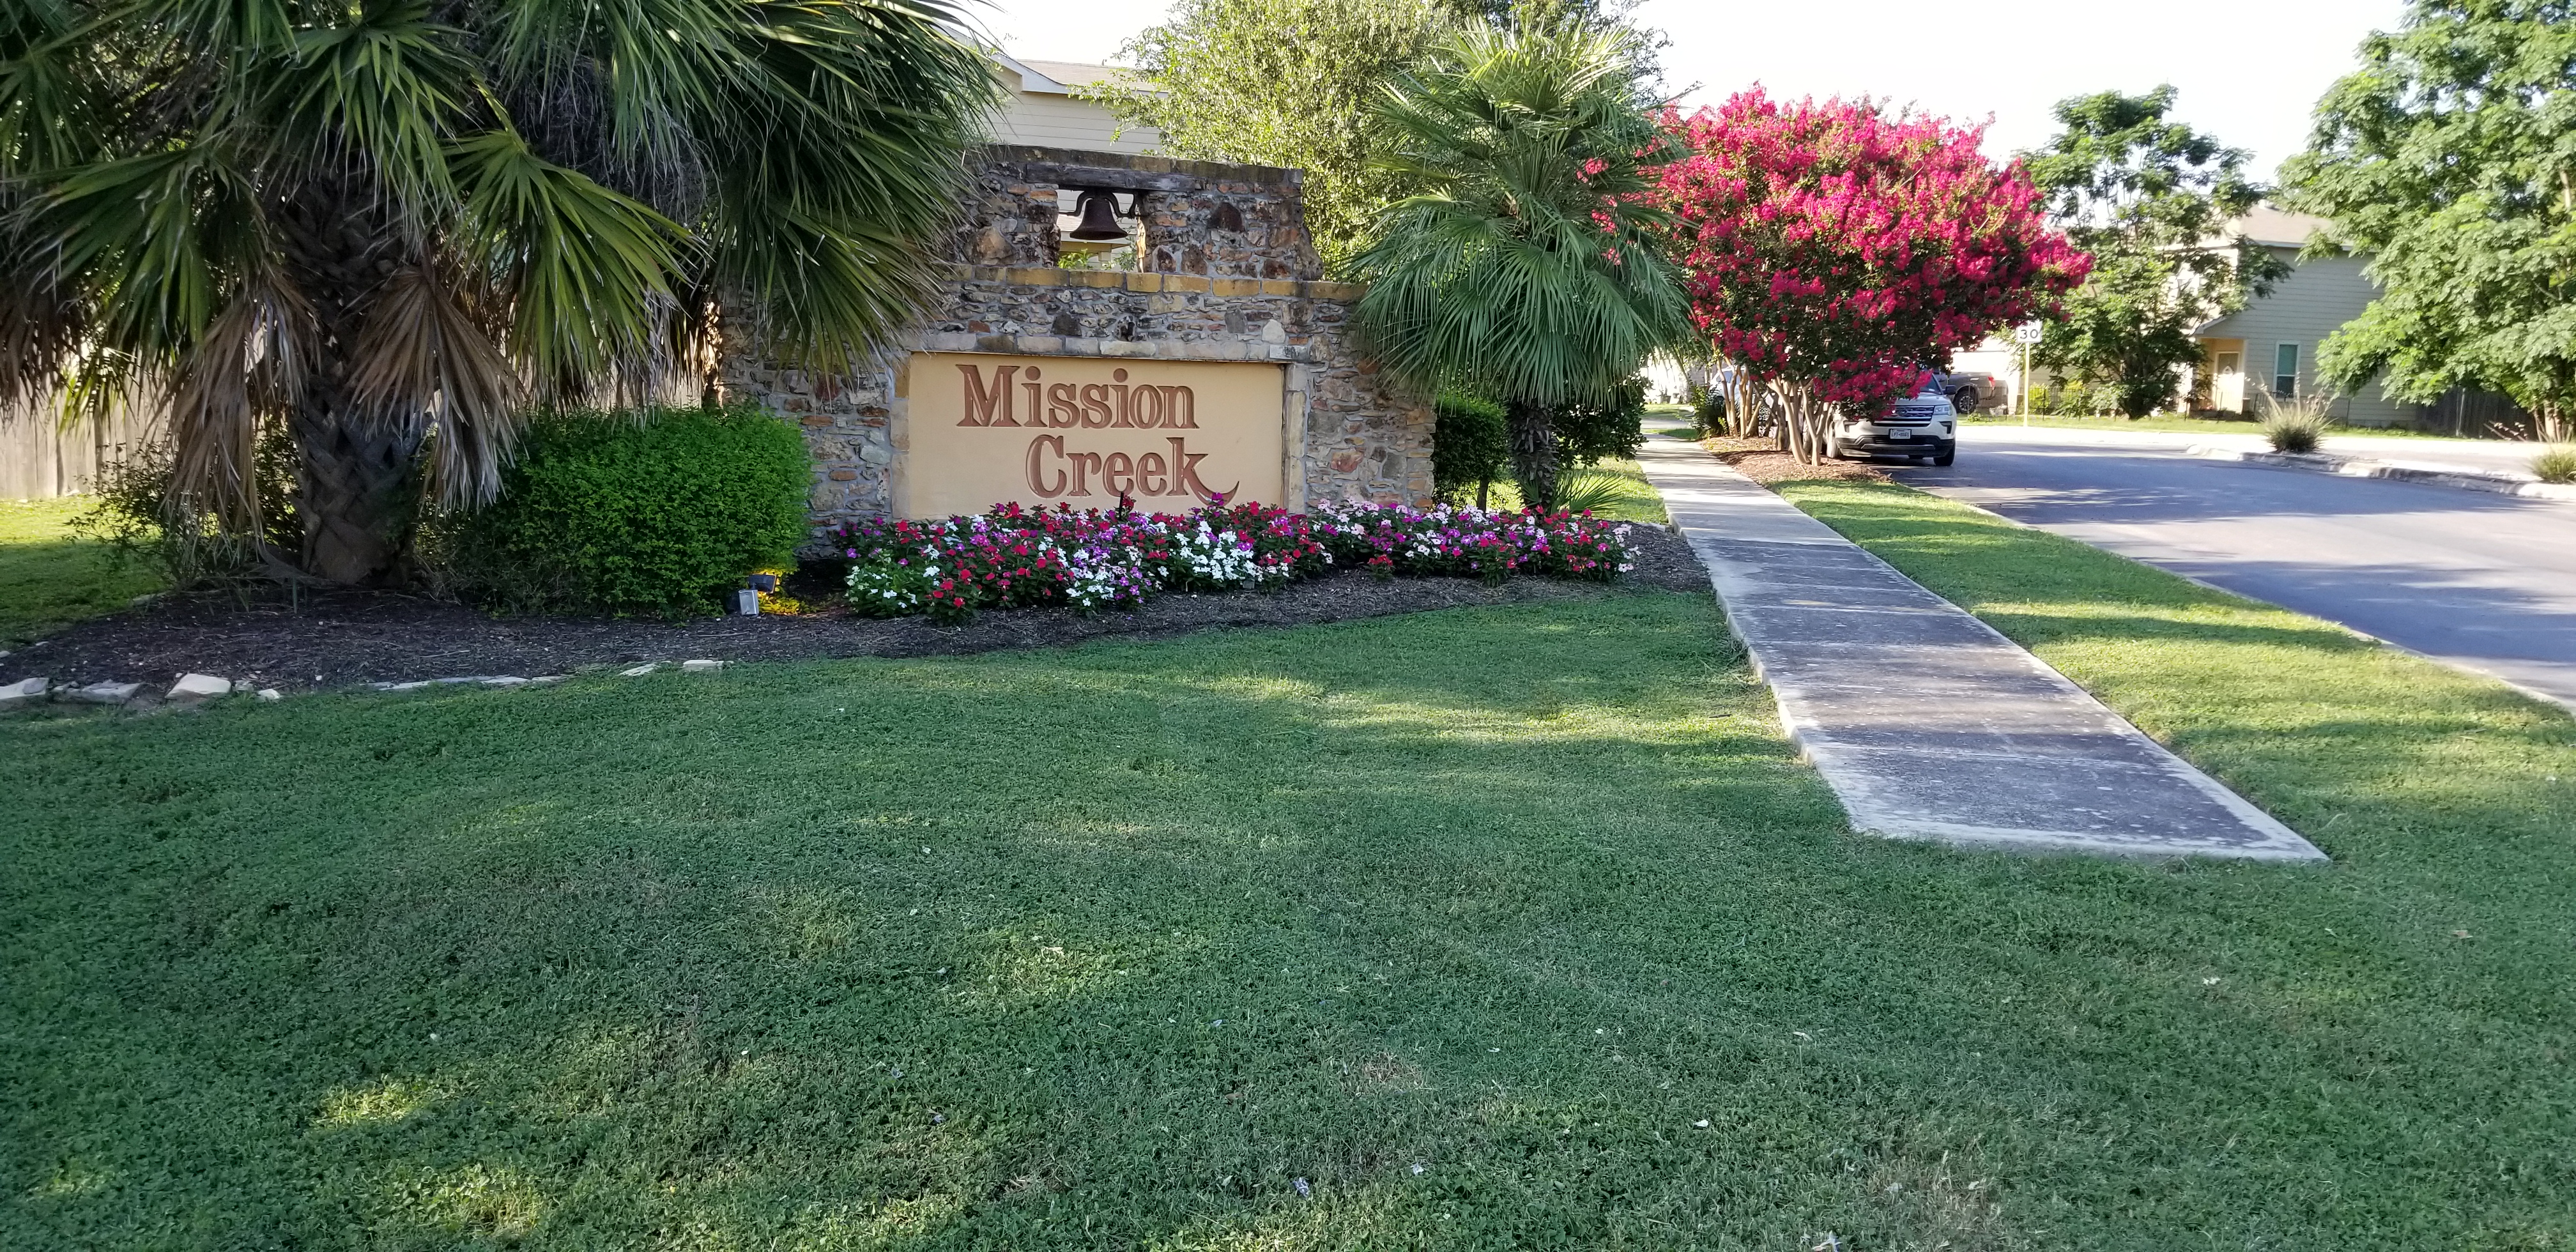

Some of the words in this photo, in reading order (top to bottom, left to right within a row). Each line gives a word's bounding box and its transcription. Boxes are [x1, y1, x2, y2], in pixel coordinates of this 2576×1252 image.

[2020, 329, 2039, 339] 30
[956, 364, 1200, 429] Mission
[1025, 435, 1240, 507] Creek
